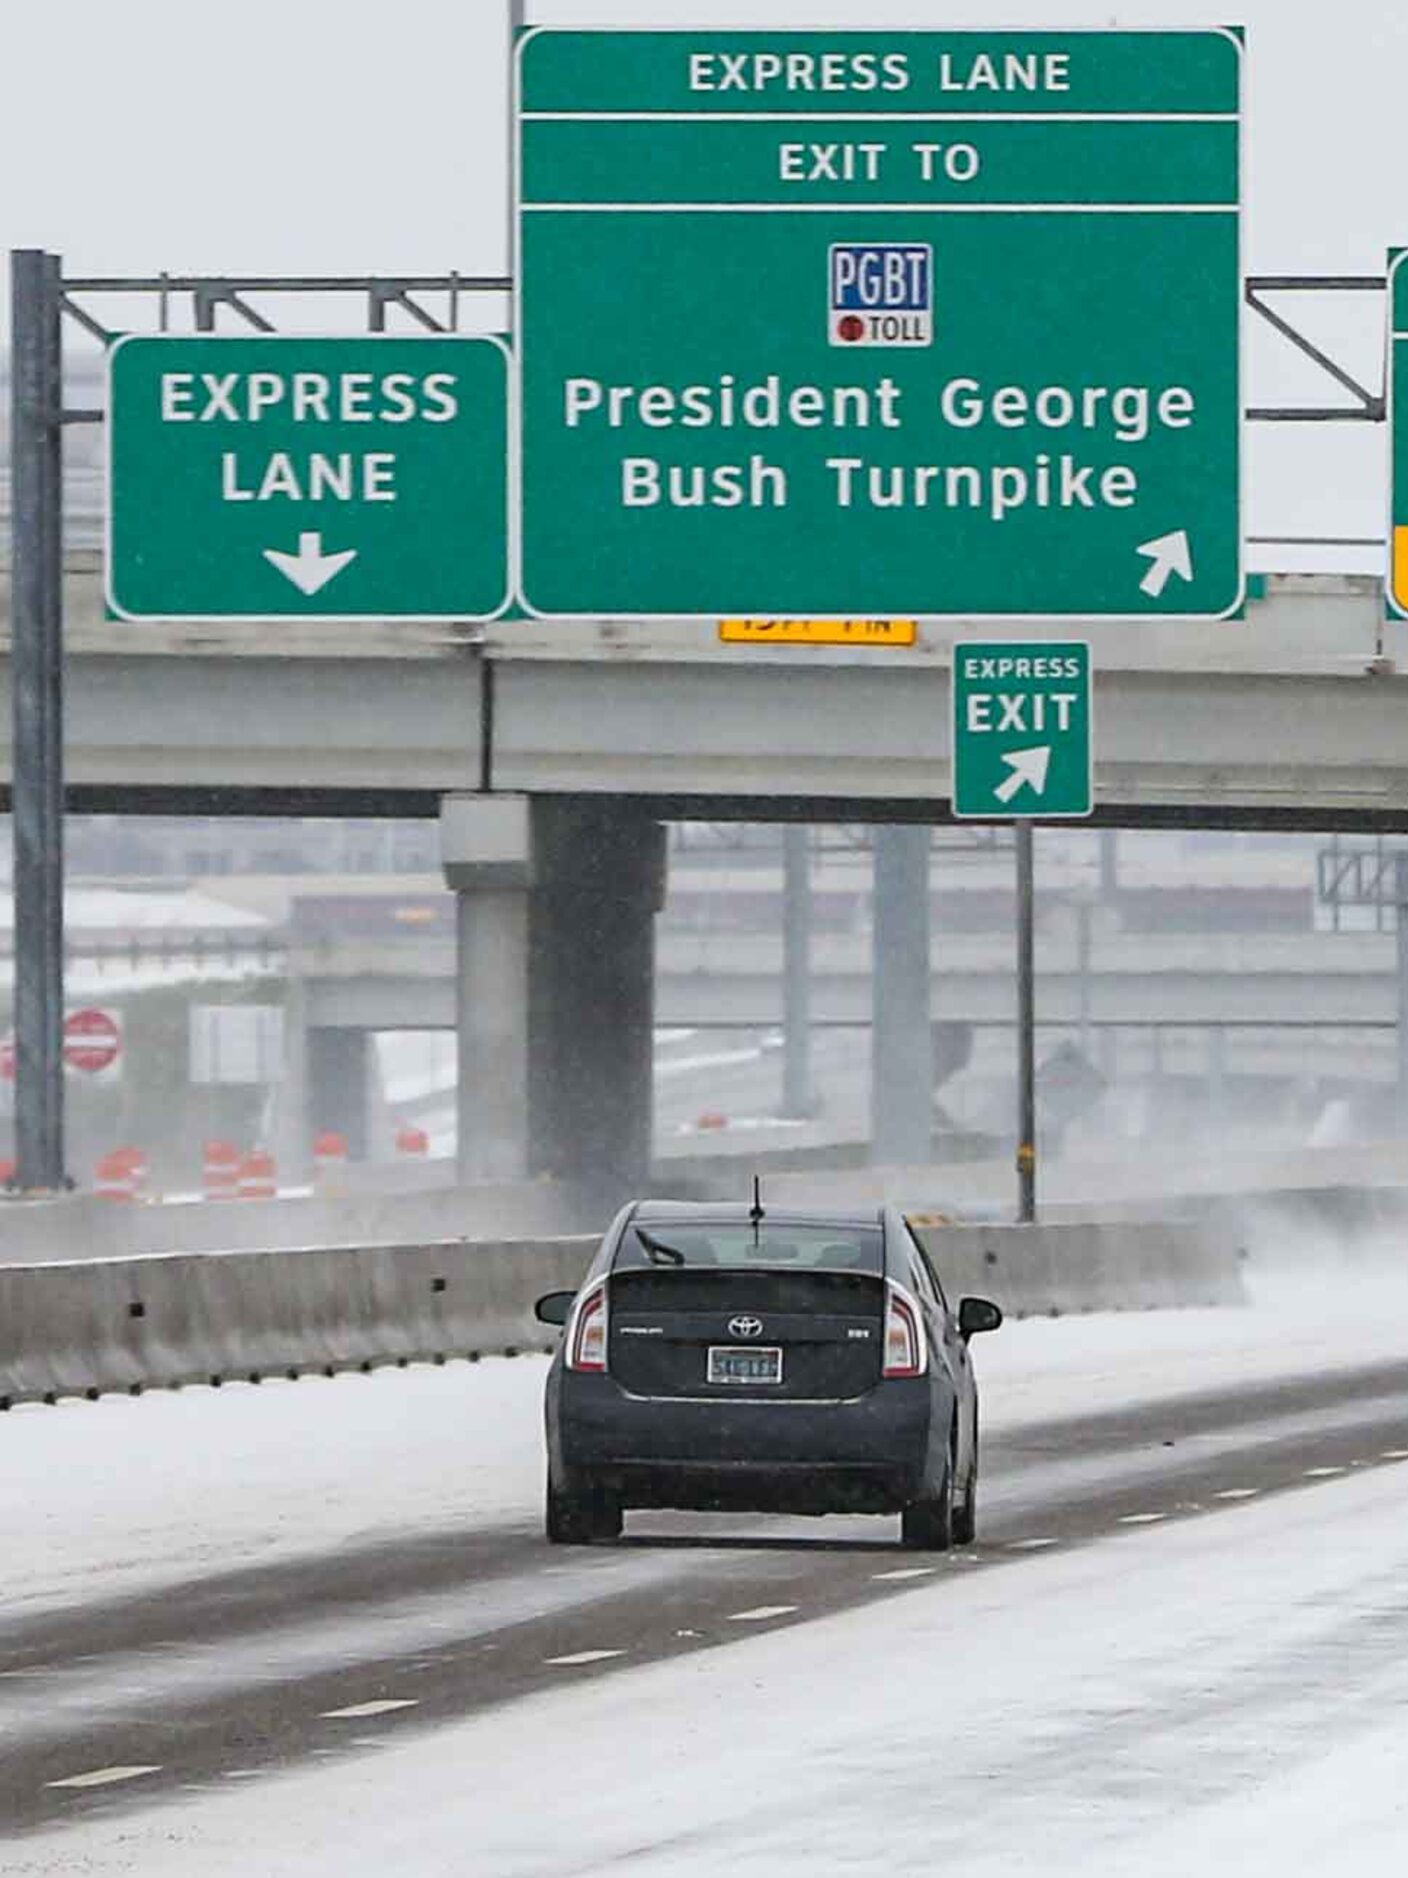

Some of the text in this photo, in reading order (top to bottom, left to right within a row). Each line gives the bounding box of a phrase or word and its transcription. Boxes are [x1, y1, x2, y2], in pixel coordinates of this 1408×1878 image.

[690, 53, 1070, 91] EXPRESS LANE
[780, 143, 979, 181] EXIT TO
[836, 251, 925, 305] PGBT
[869, 315, 925, 340] TOLL
[162, 373, 457, 422] EXPRESS
[566, 375, 1194, 442] President George
[223, 452, 396, 501] LANE
[623, 454, 1137, 520] Bush Turnpike
[965, 658, 1079, 679] EXPRESS
[967, 693, 1077, 732] EXIT
